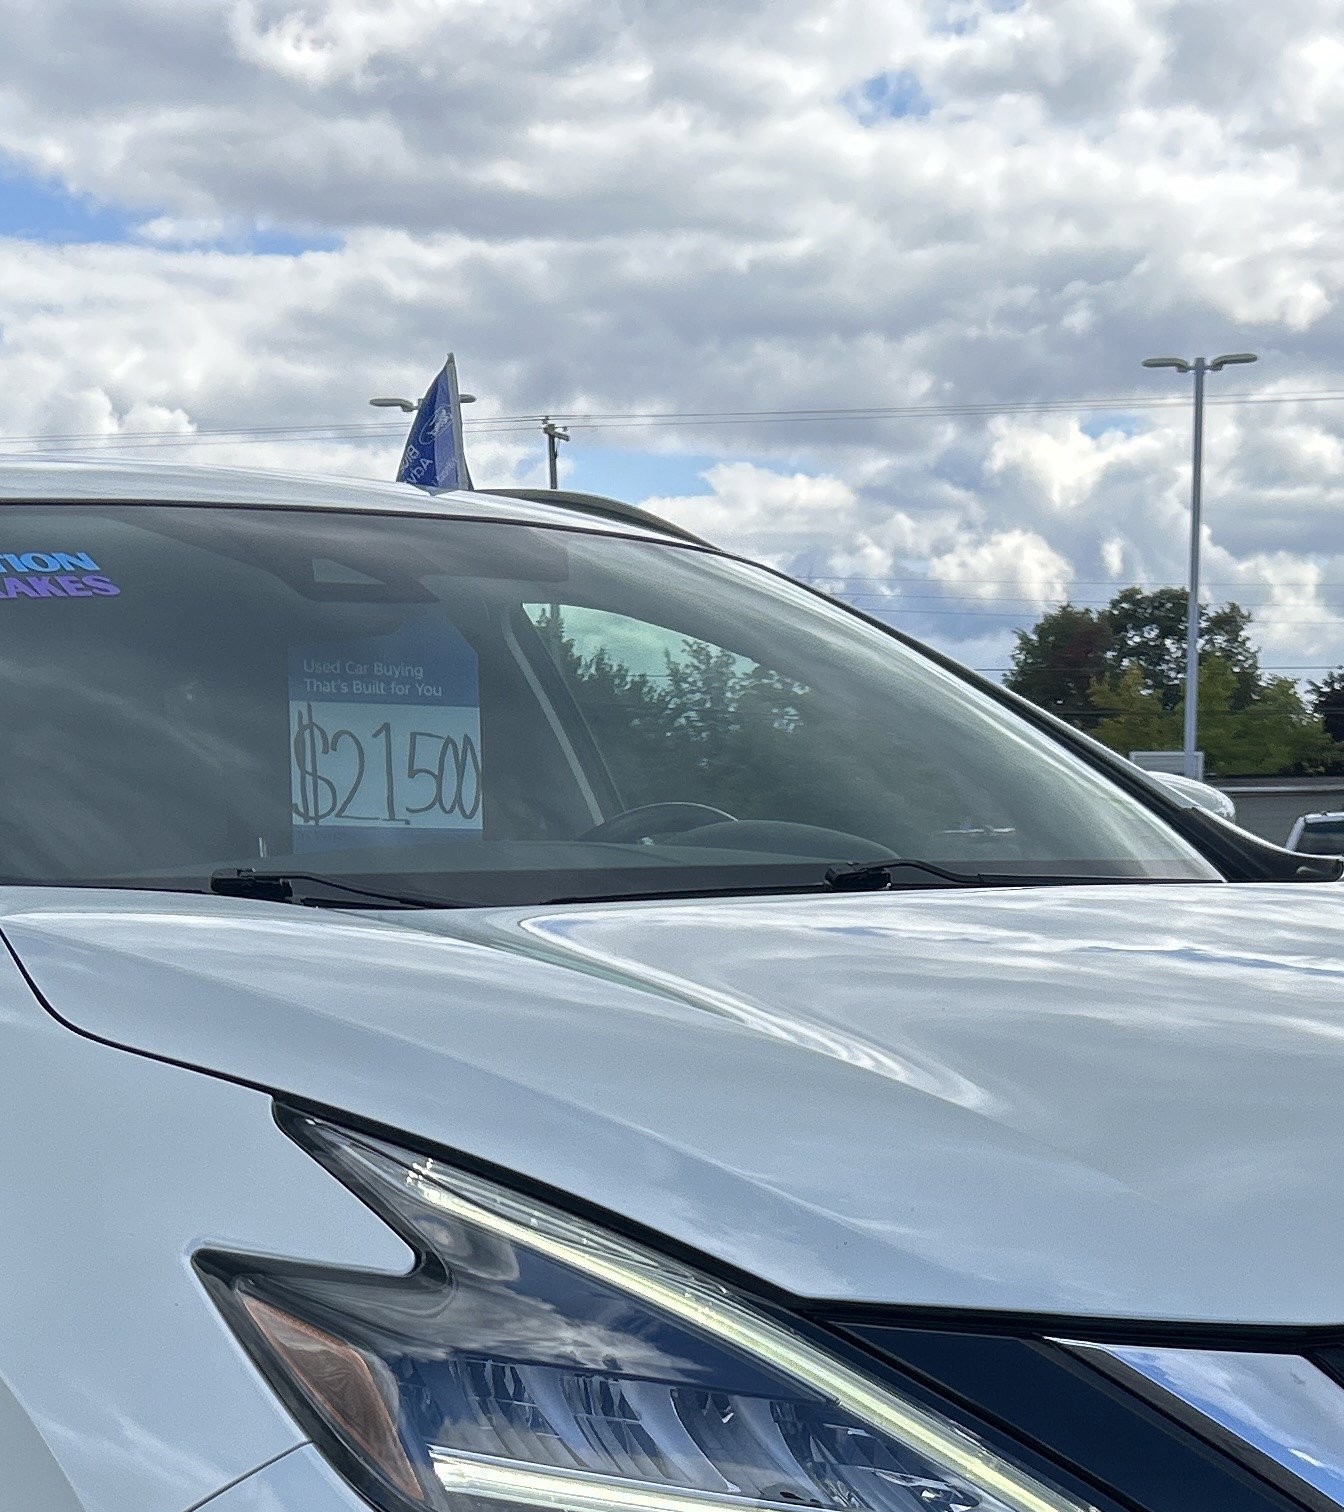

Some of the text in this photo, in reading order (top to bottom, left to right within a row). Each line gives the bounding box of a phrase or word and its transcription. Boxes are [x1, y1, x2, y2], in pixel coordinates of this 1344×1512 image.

[303, 659, 424, 679] Used Car Buying
[305, 678, 443, 697] That's Built for You
